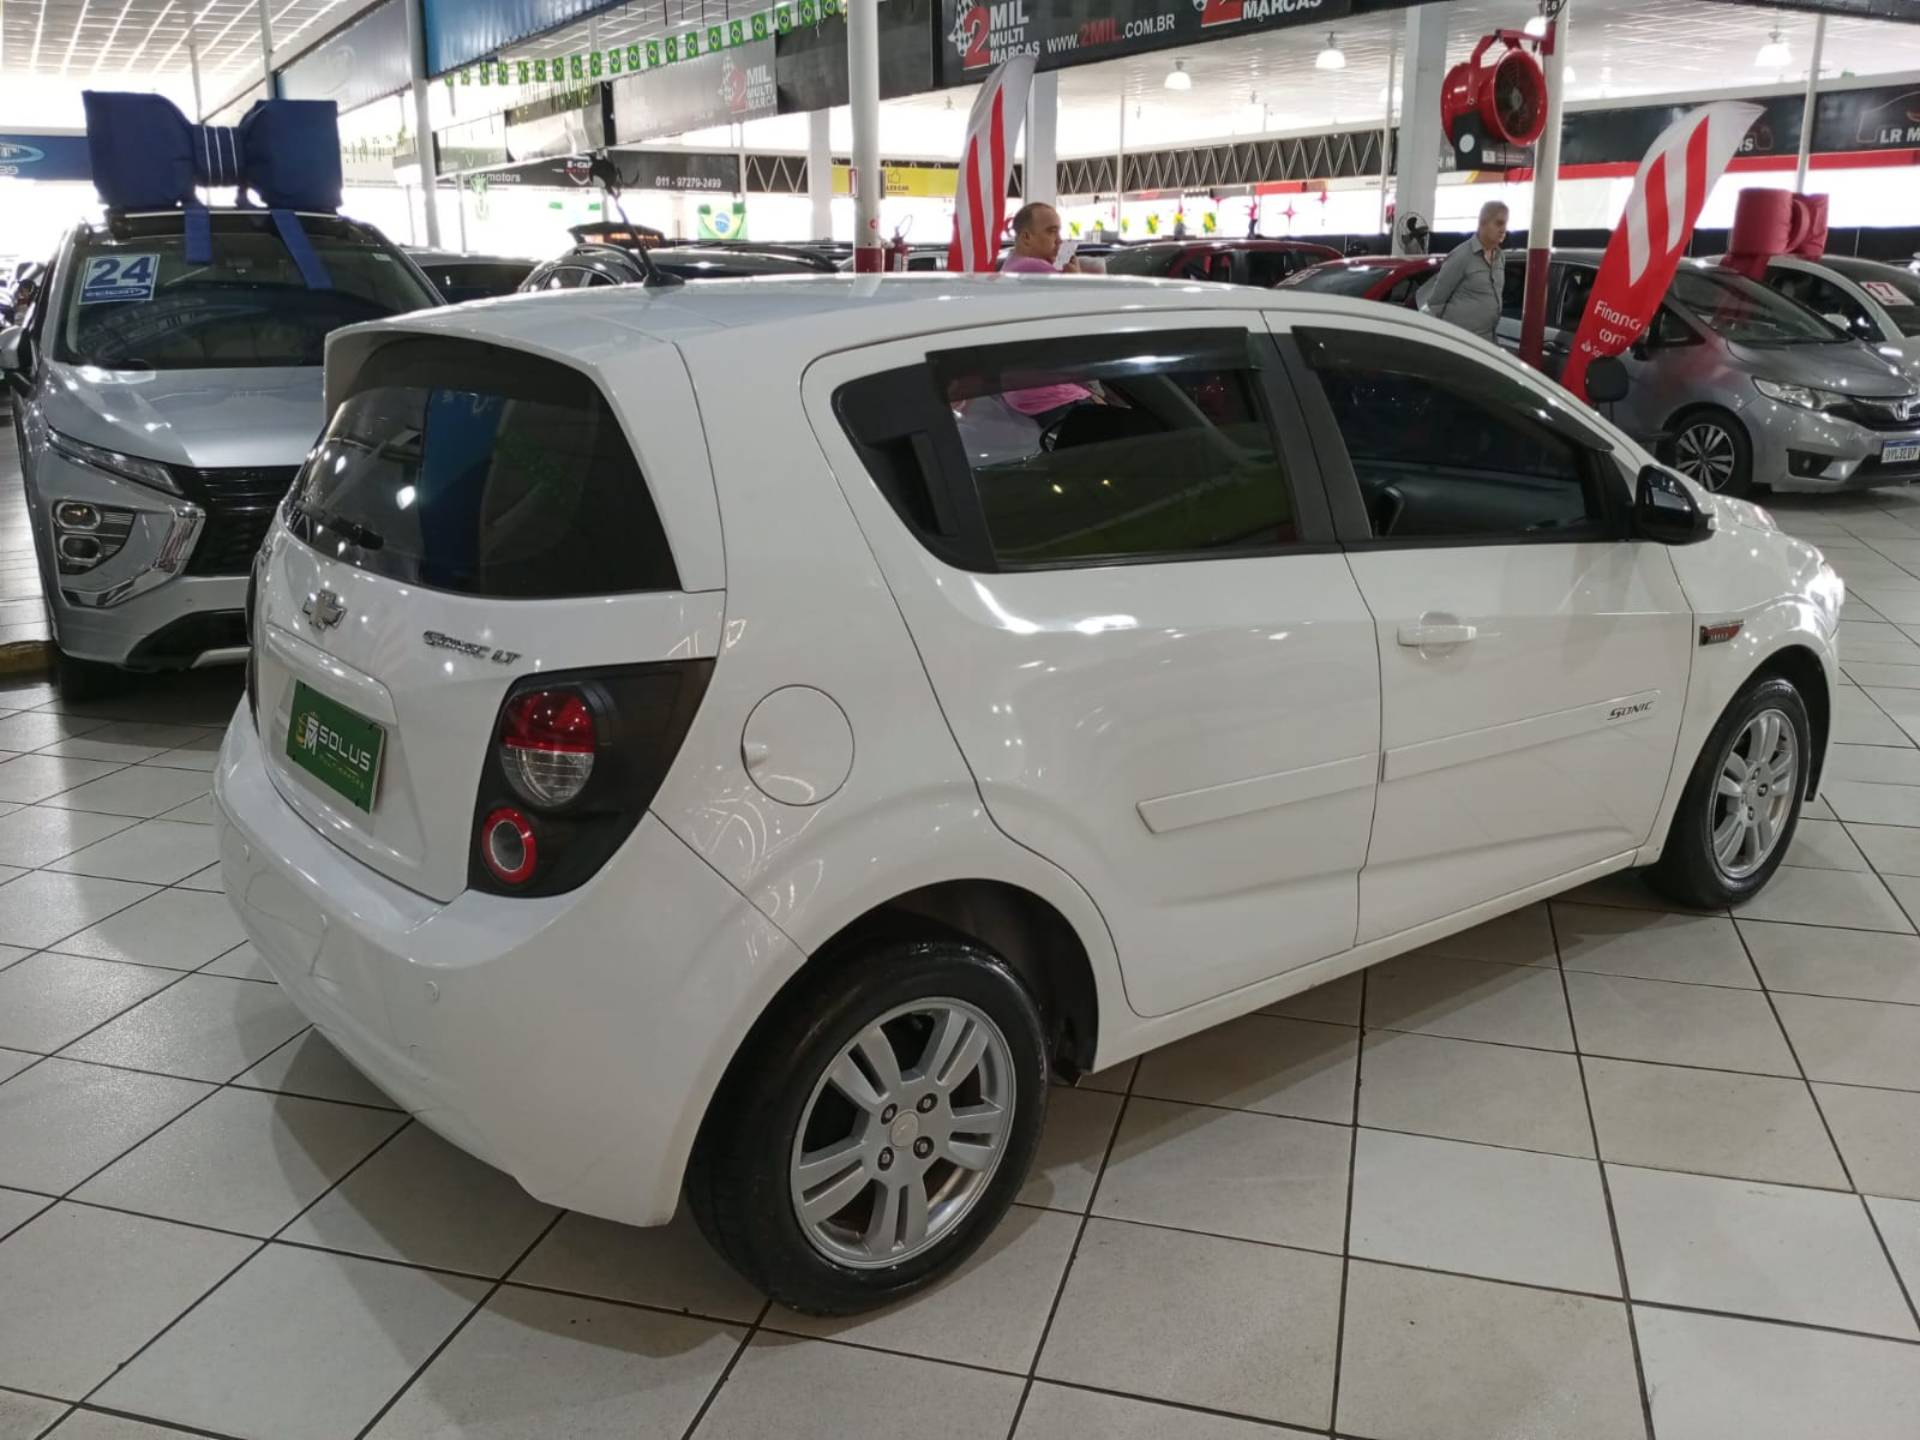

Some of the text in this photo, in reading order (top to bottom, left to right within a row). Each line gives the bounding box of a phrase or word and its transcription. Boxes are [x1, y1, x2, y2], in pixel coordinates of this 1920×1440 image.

[963, 0, 1029, 69] 2 MIL
[990, 26, 1024, 48] MULTI
[990, 40, 1040, 65] MARCAS
[746, 64, 771, 88] MIL
[87, 256, 152, 287] 24
[491, 649, 522, 665] LT
[318, 725, 371, 771] SOLUS
